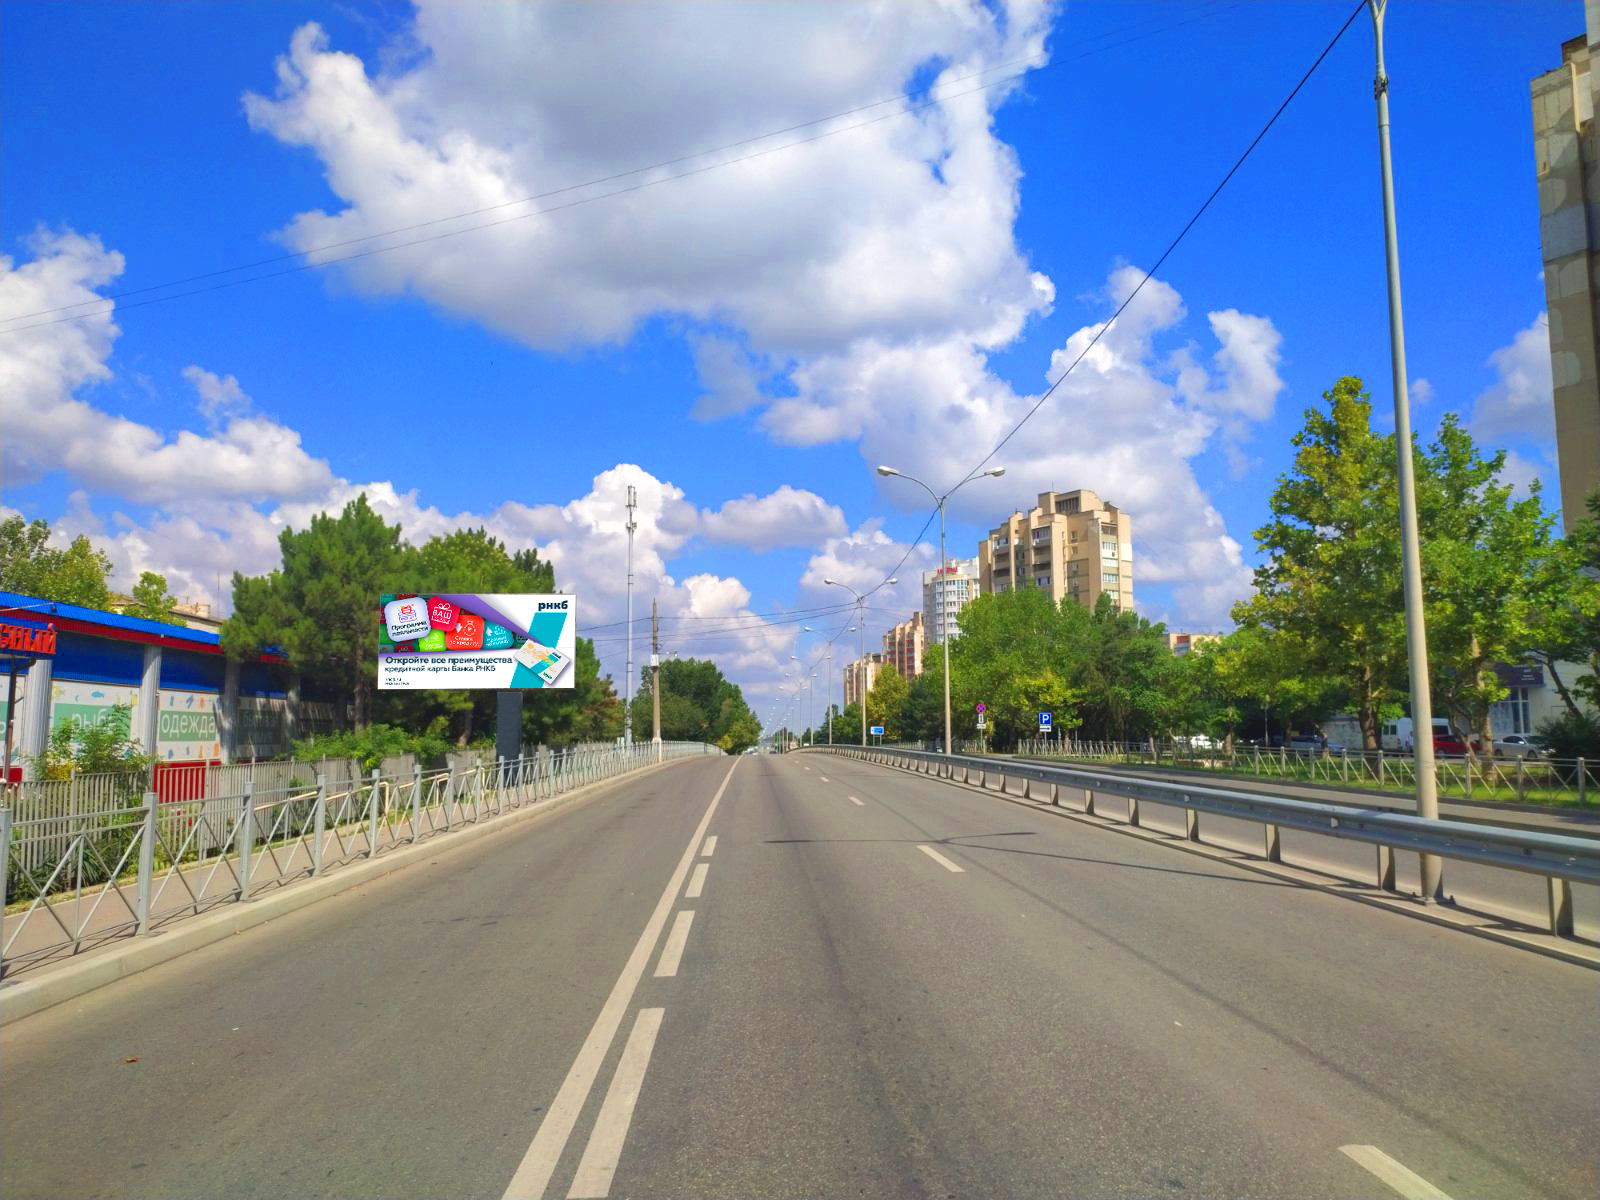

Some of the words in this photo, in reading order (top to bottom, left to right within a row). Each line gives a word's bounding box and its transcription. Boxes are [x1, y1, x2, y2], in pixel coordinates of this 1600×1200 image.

[538, 600, 568, 611] рнкб
[391, 621, 428, 631] Программа
[385, 656, 429, 665] Откройте
[448, 657, 513, 665] преимущества
[385, 665, 425, 673] кредитной
[161, 714, 215, 738] одежда
